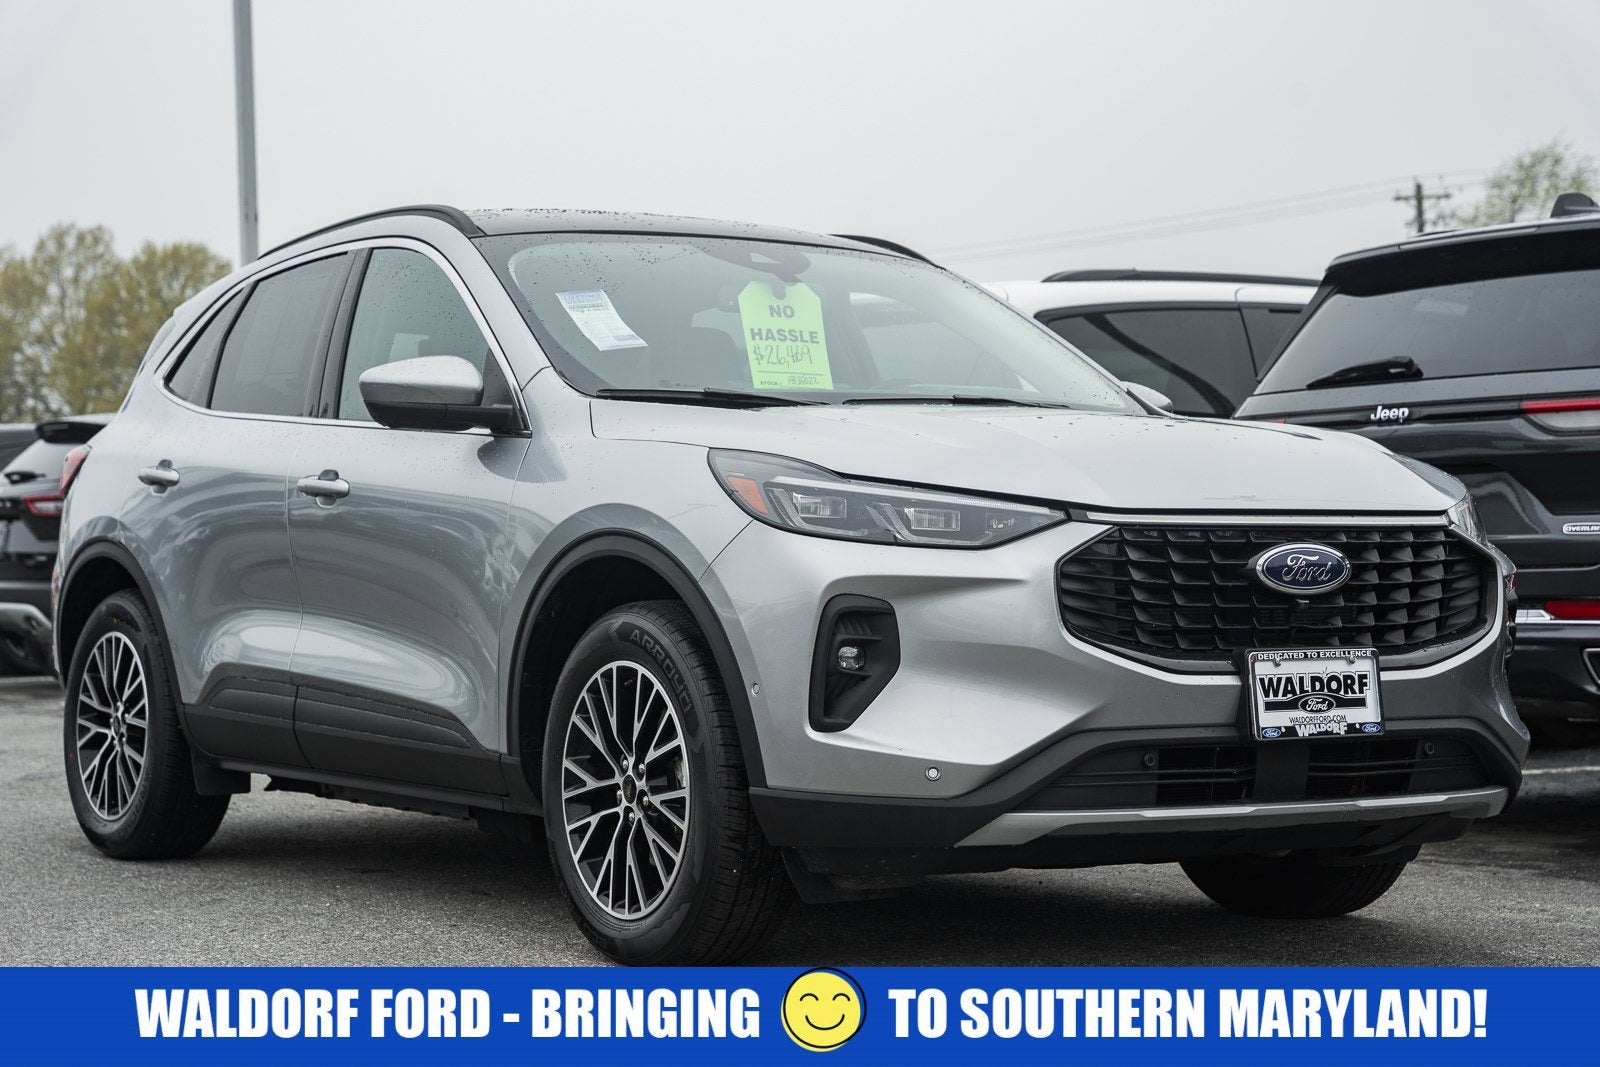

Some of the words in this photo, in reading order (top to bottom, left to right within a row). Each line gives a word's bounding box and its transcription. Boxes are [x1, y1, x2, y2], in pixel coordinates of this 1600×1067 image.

[769, 304, 795, 319] NO
[750, 328, 820, 344] HASSLE
[1370, 405, 1409, 423] Jeep
[1281, 553, 1332, 581] Ford
[1257, 652, 1305, 660] DEDICATED
[1319, 650, 1372, 658] EXCELLENCE
[1257, 672, 1369, 699] WALDORF
[1305, 698, 1329, 711] Ford
[1288, 715, 1347, 725] WALDORFFORD.COM
[1265, 729, 1279, 737] Ford
[1295, 722, 1348, 737] WALDORF
[1365, 724, 1378, 732] Ford
